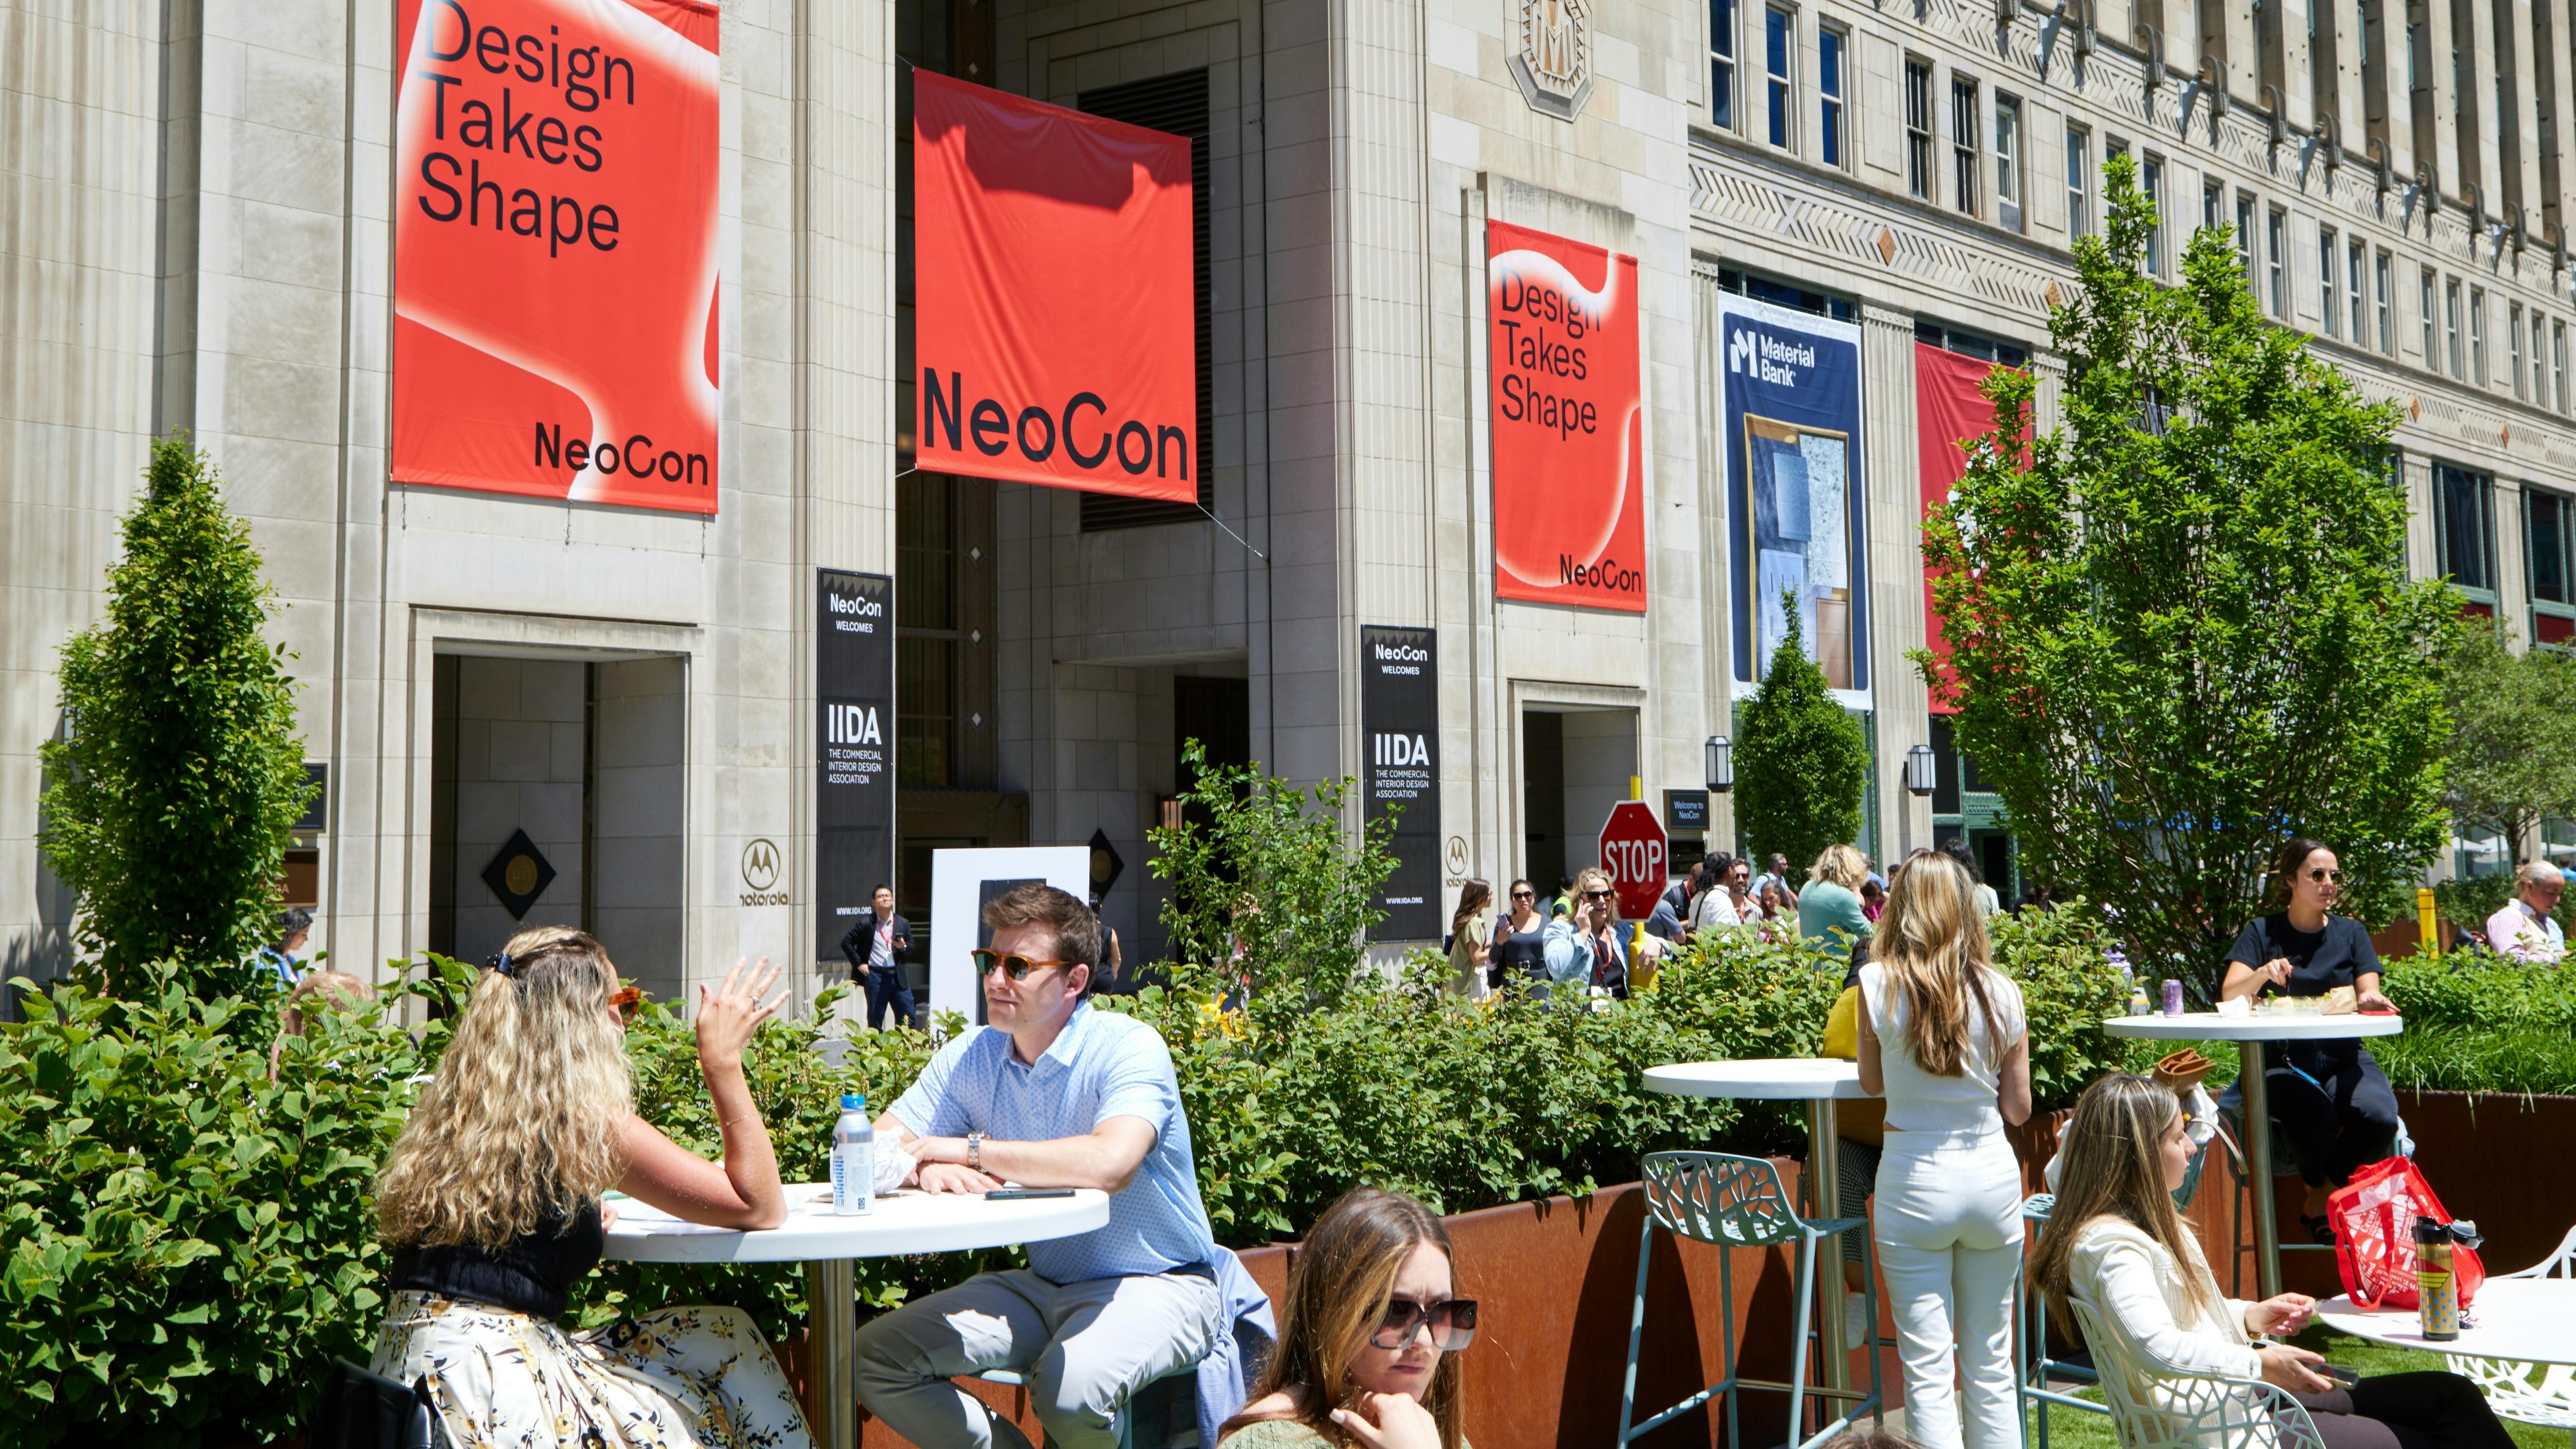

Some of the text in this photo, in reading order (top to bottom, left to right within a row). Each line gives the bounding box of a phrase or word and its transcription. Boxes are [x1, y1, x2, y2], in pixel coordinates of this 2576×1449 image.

[425, 0, 635, 112] Design
[418, 70, 603, 173] Takes
[418, 152, 619, 259] Shape
[1502, 267, 1600, 339] Design
[1500, 319, 1586, 381] Takes
[1760, 334, 1815, 368] Material
[1501, 374, 1596, 441] Shape
[924, 367, 1188, 481] NeoCon
[535, 422, 709, 486] NeoCon
[1560, 553, 1641, 593] NeoCon
[830, 593, 882, 617] NeoCon
[836, 620, 874, 634] WELCOMES
[1375, 644, 1428, 662] NeoCon
[1382, 665, 1420, 675] WELCOMES
[828, 704, 882, 745] IIDA
[829, 749, 882, 761] THE COMMERCIAL
[1375, 734, 1430, 766] IIDA
[829, 762, 882, 773] INTERIOR DESIGN
[829, 774, 869, 785] ASSOCIATION
[1376, 769, 1430, 779] THE COMMERCIAL
[1376, 779, 1429, 789] INTERIOR DESIGN
[1376, 790, 1417, 798] ASSOCIATION
[1674, 801, 1704, 810] Welcome to
[1679, 810, 1700, 819] NeoCon
[1605, 840, 1662, 883] STOP
[836, 906, 872, 916] WWW.IIDA.ORG
